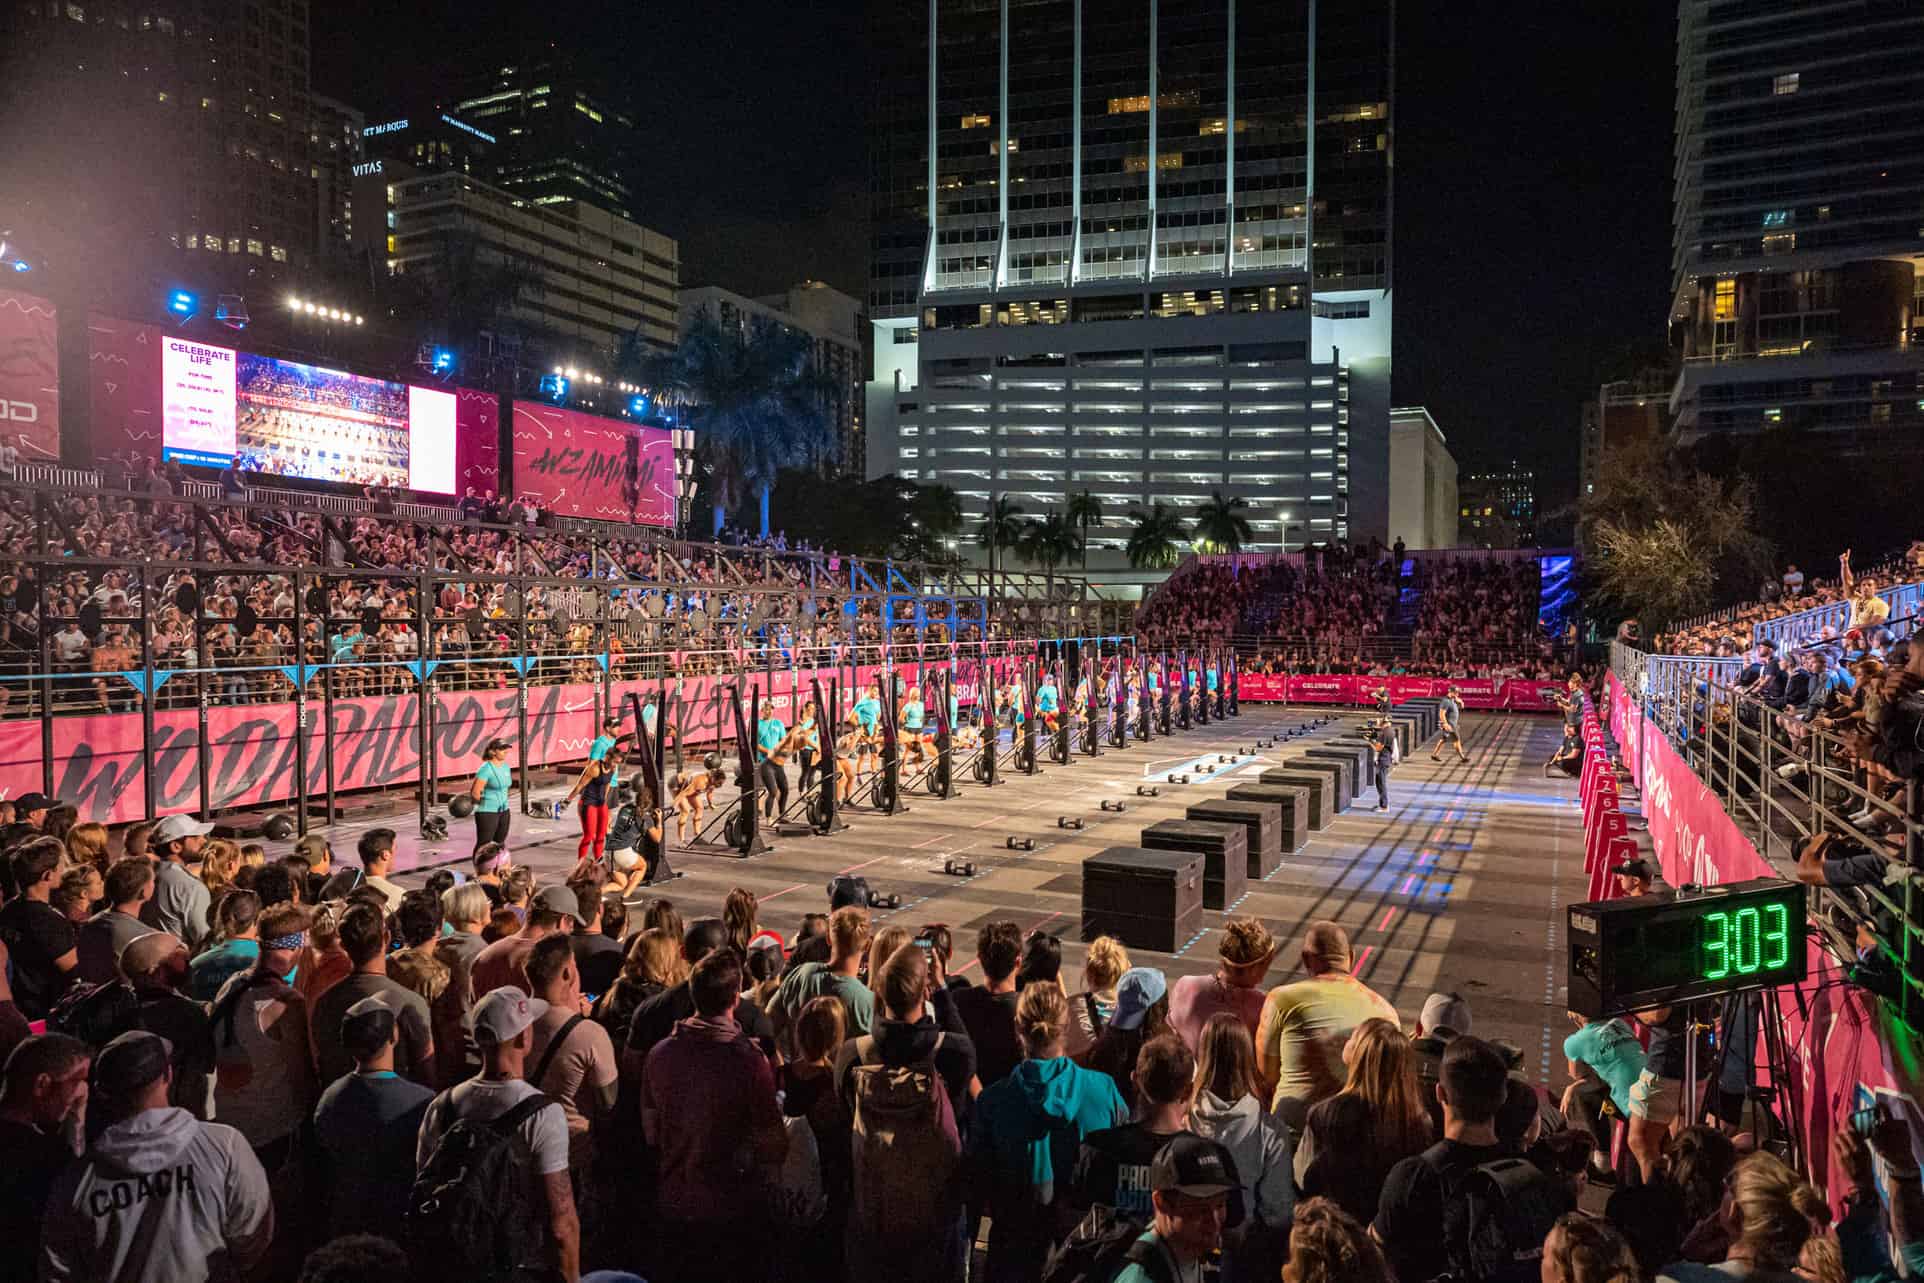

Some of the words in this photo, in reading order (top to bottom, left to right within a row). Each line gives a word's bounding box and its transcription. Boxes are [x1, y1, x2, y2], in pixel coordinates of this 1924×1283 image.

[375, 119, 409, 135] MARQUIS
[352, 160, 382, 177] VITAS
[170, 342, 231, 361] CELEBRATE
[190, 354, 213, 366] LIFE
[56, 686, 561, 821] WODAPALOOZA
[1602, 780, 1611, 789] 7
[1602, 798, 1612, 808] 6
[1609, 819, 1619, 830] 5
[1620, 848, 1630, 859] 4
[1706, 903, 1788, 979] 3:03
[90, 1163, 194, 1218] COACH
